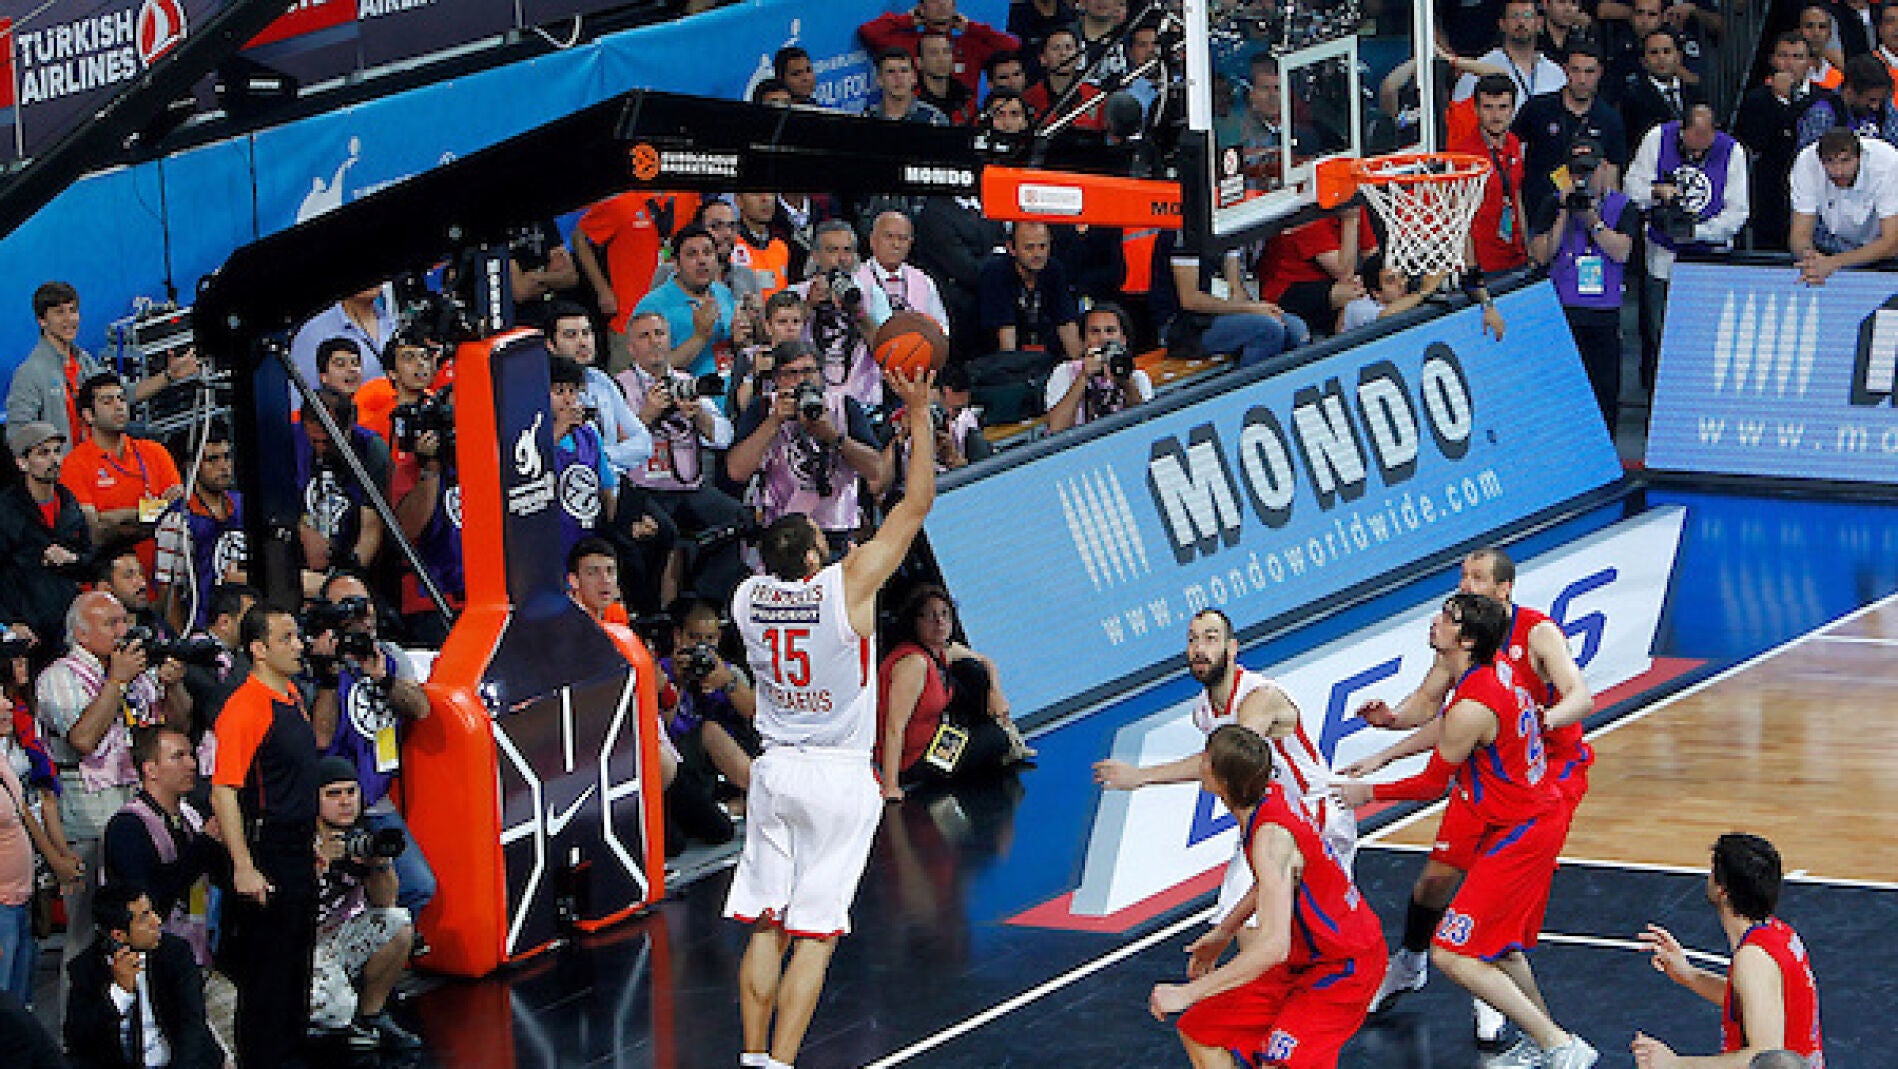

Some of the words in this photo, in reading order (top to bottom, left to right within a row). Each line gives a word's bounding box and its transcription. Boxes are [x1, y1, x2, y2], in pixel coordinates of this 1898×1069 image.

[18, 8, 133, 67] TURKISH
[21, 48, 137, 105] AIRLINES
[905, 165, 975, 188] MONDO
[1147, 341, 1474, 566] MONDO
[1101, 467, 1504, 647] www.mondoworldwide.com
[761, 627, 811, 687] 15
[1437, 908, 1475, 947] 23
